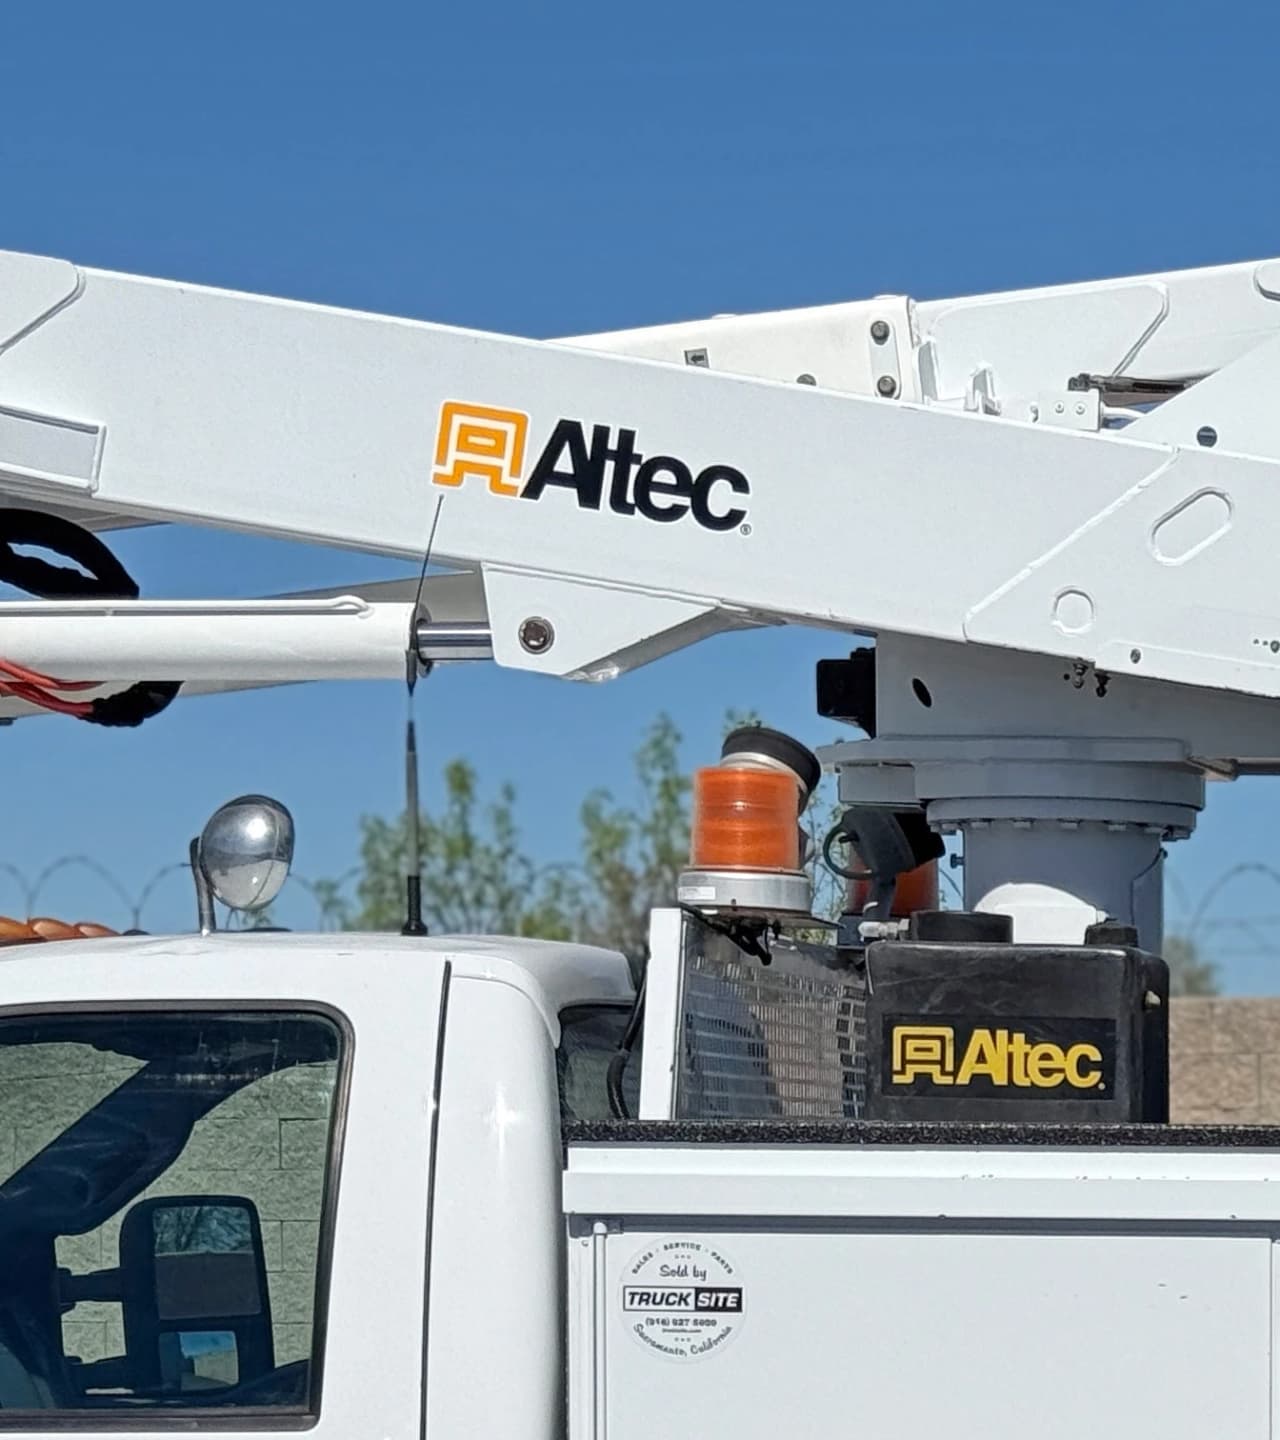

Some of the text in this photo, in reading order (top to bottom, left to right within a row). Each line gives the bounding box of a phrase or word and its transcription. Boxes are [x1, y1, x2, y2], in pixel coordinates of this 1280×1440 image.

[520, 418, 750, 532] Altec
[955, 1028, 1103, 1089] Altec
[631, 1242, 734, 1275] SALES SERVICE PARTS
[659, 1264, 707, 1282] Sold by
[627, 1291, 740, 1308] TRUCK SITE
